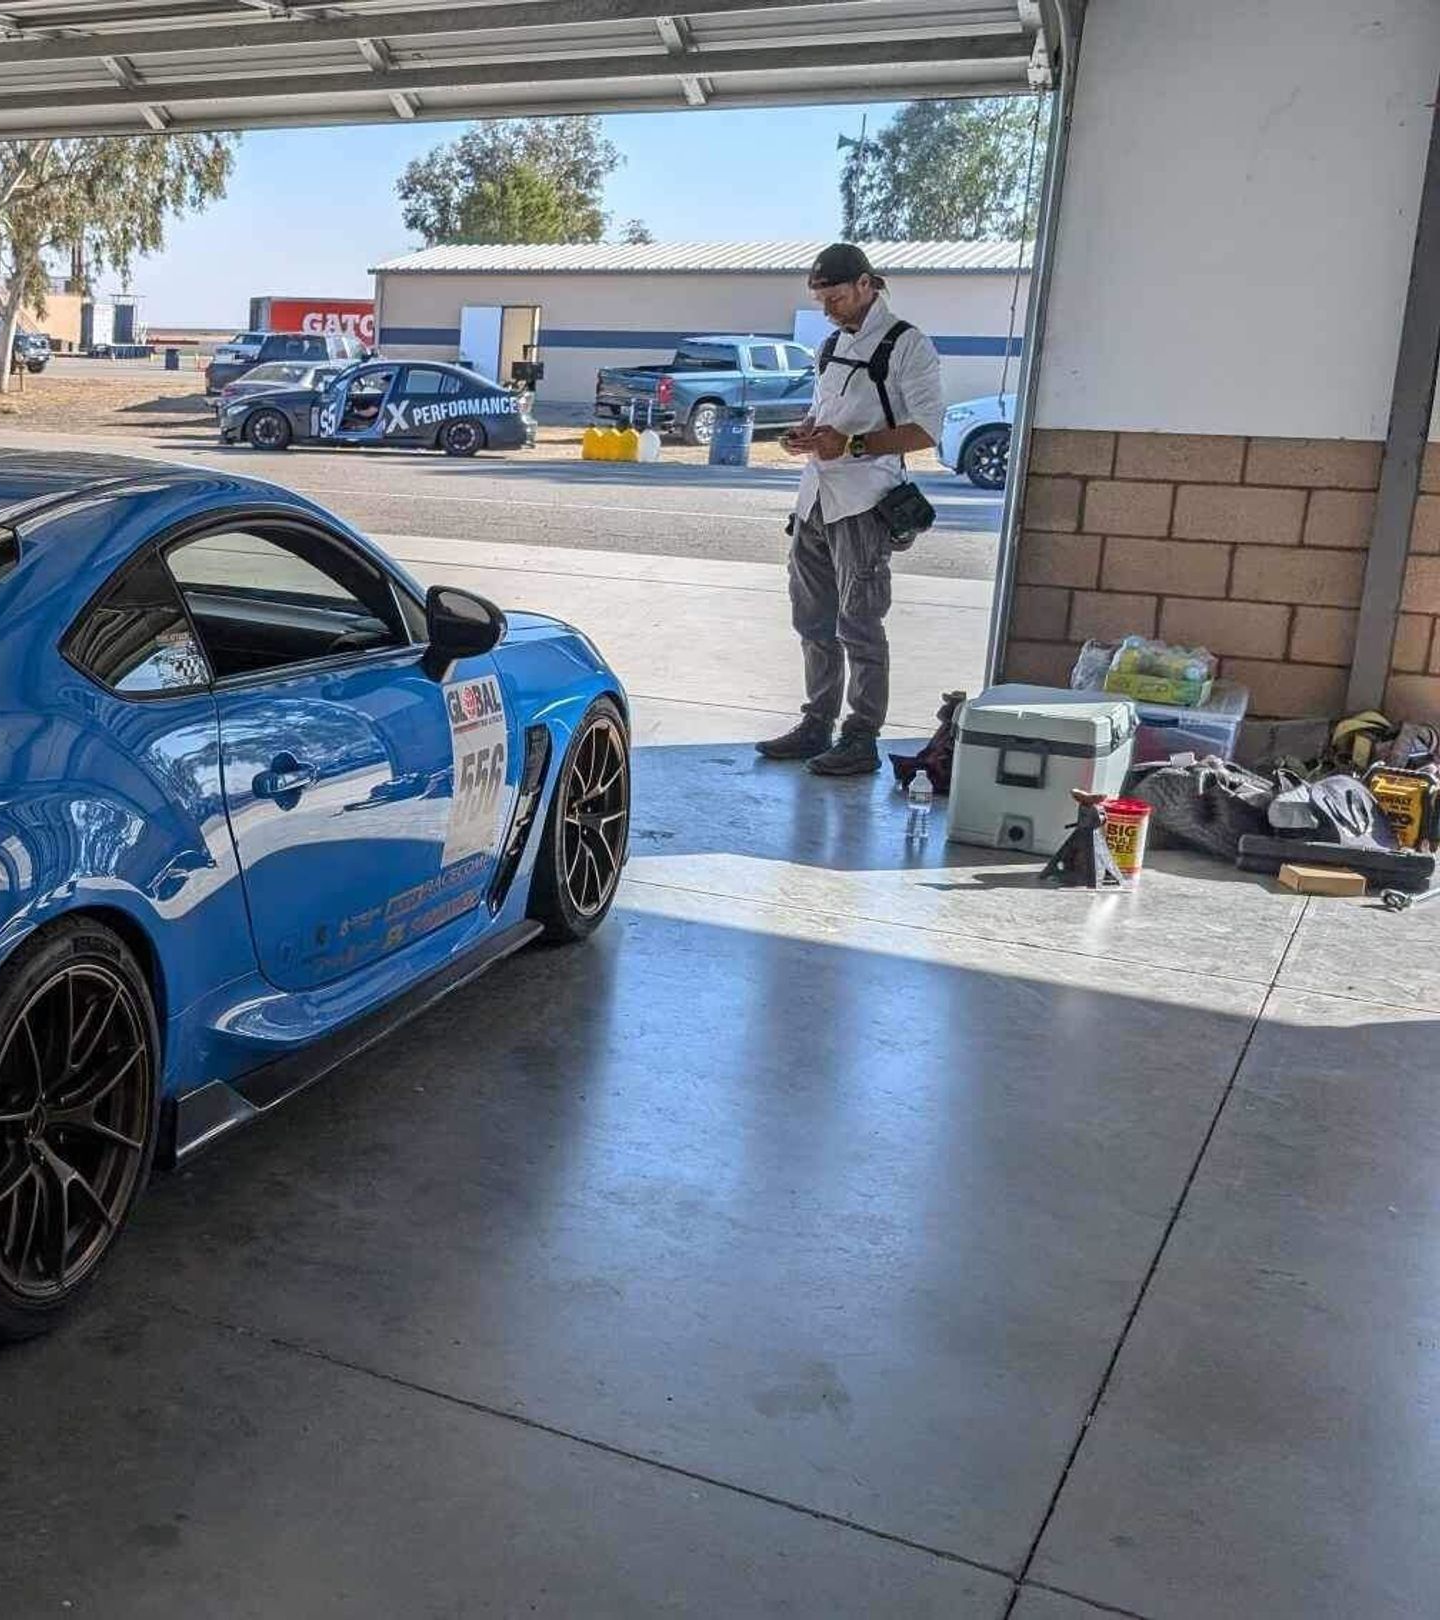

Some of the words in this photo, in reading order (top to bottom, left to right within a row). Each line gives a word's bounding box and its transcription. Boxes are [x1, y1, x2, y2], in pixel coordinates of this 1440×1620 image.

[387, 401, 409, 433] X
[413, 398, 519, 426] PERFORMANCE
[1107, 824, 1138, 837] BIG
